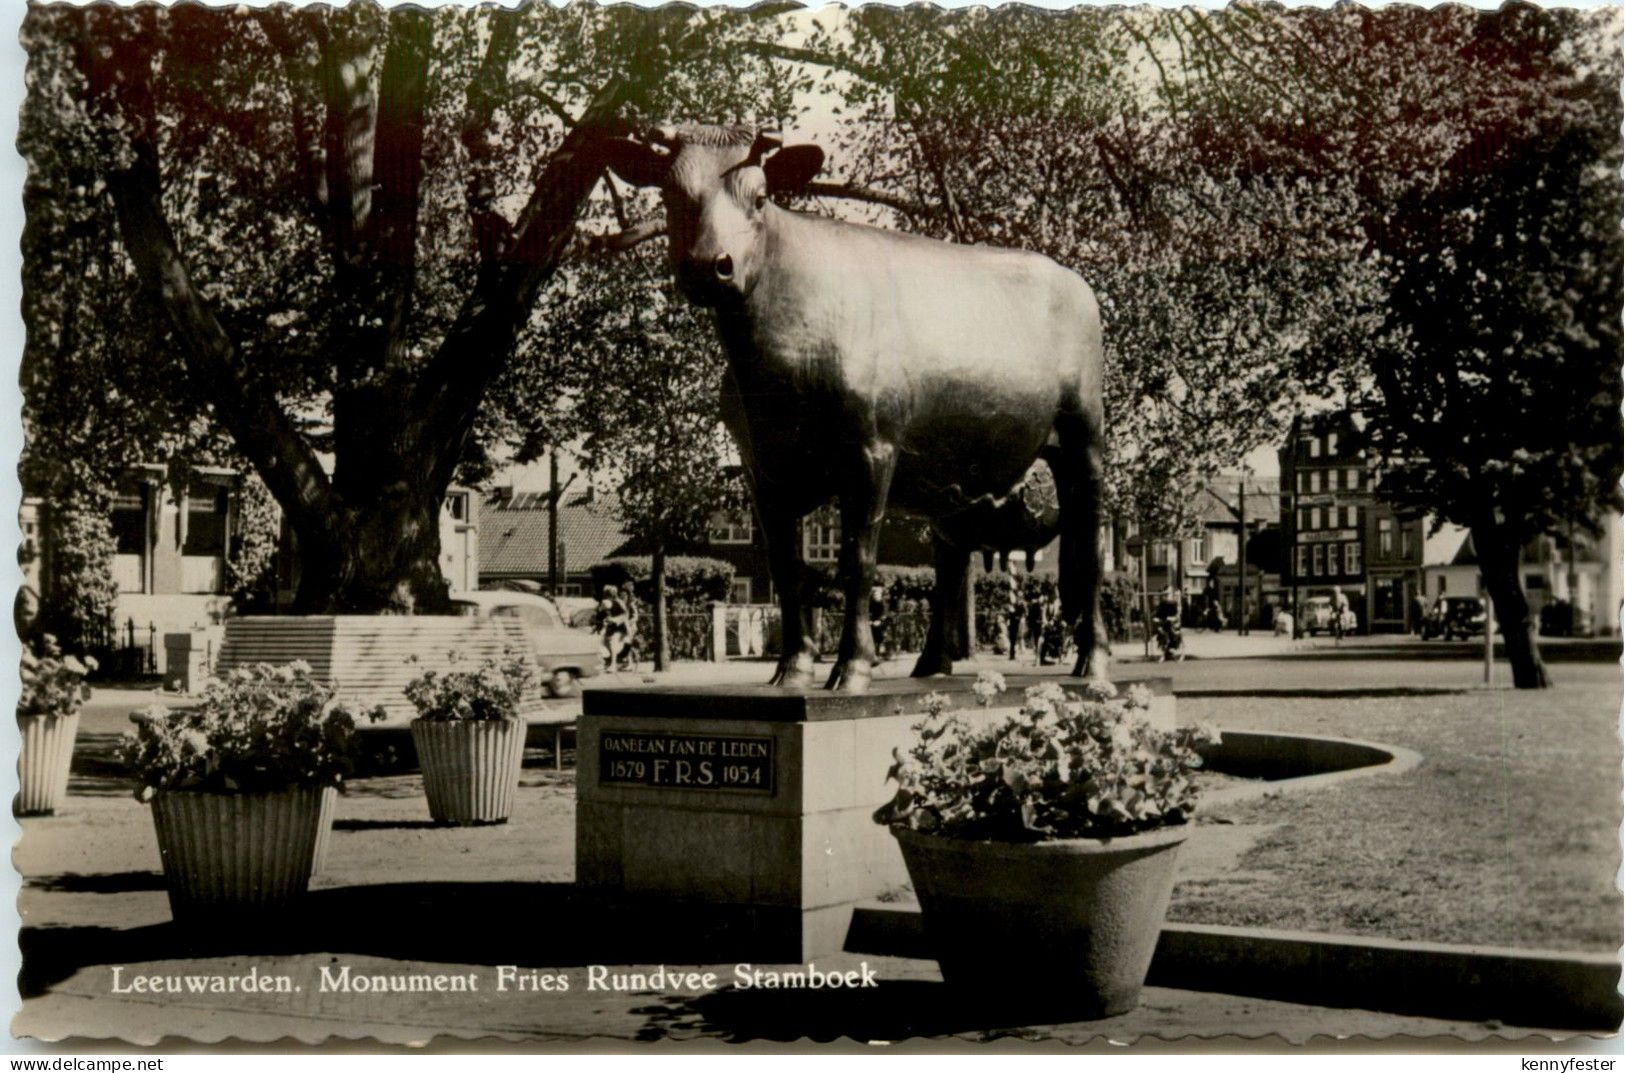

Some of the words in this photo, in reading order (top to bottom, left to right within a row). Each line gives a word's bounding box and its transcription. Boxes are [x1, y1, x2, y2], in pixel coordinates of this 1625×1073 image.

[604, 737, 666, 753] OANBEAN
[669, 739, 696, 754] FAN
[699, 741, 716, 756] DE
[721, 742, 768, 758] LEDEN
[610, 761, 646, 778] 1879
[723, 766, 762, 784] 1954
